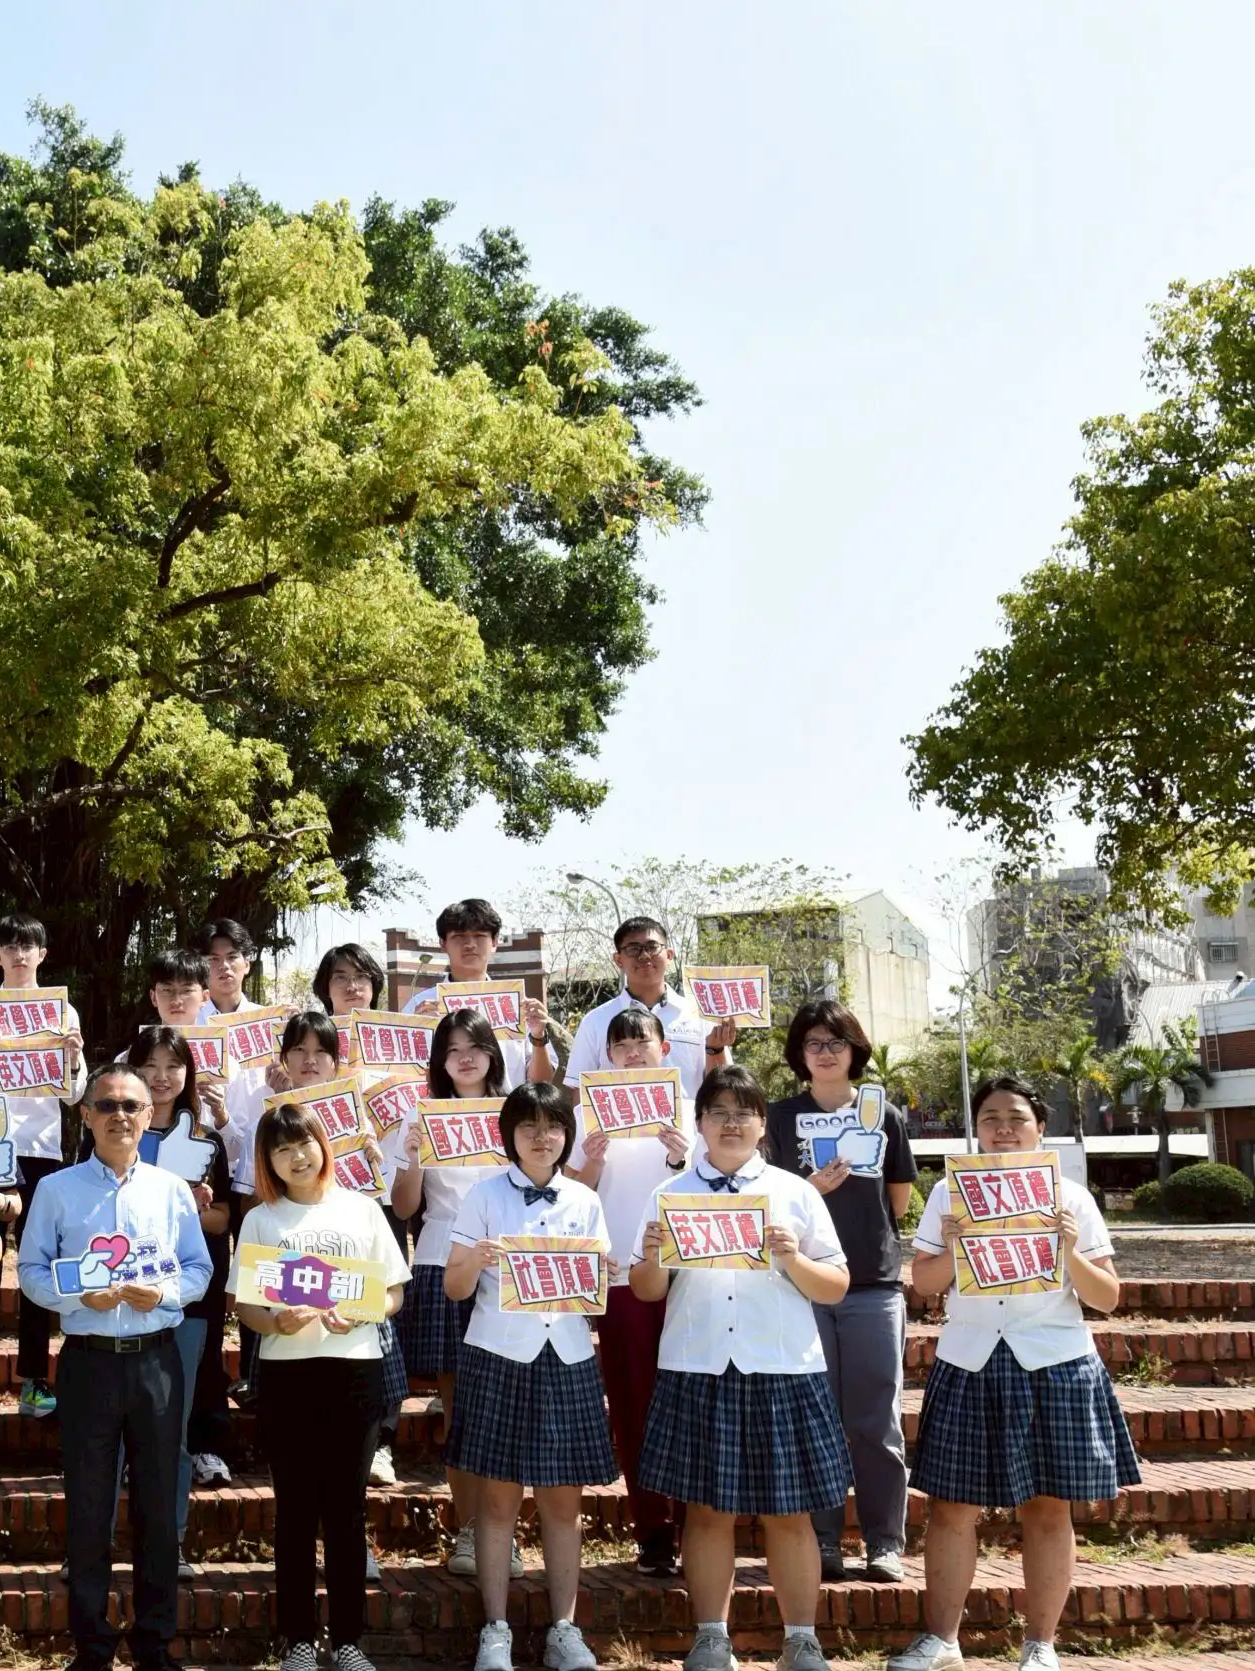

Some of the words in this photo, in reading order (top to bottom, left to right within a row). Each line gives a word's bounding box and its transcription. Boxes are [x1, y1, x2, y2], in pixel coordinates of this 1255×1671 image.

[694, 980, 761, 1015] 數學頂標
[189, 1040, 220, 1070] 頂標
[360, 1025, 430, 1064] 數學頂標
[312, 1097, 358, 1136] 頂標
[593, 1085, 674, 1129] 數學頂標
[799, 1112, 858, 1131] Good
[428, 1114, 504, 1155] 國文頂標
[333, 1154, 374, 1190] 頂標
[961, 1171, 1055, 1217] 國文頂標
[671, 1212, 762, 1257] 英文頂標
[254, 1259, 365, 1301] 高中部
[512, 1254, 597, 1300] 社會頂標
[966, 1236, 1055, 1284] 社會頂標
